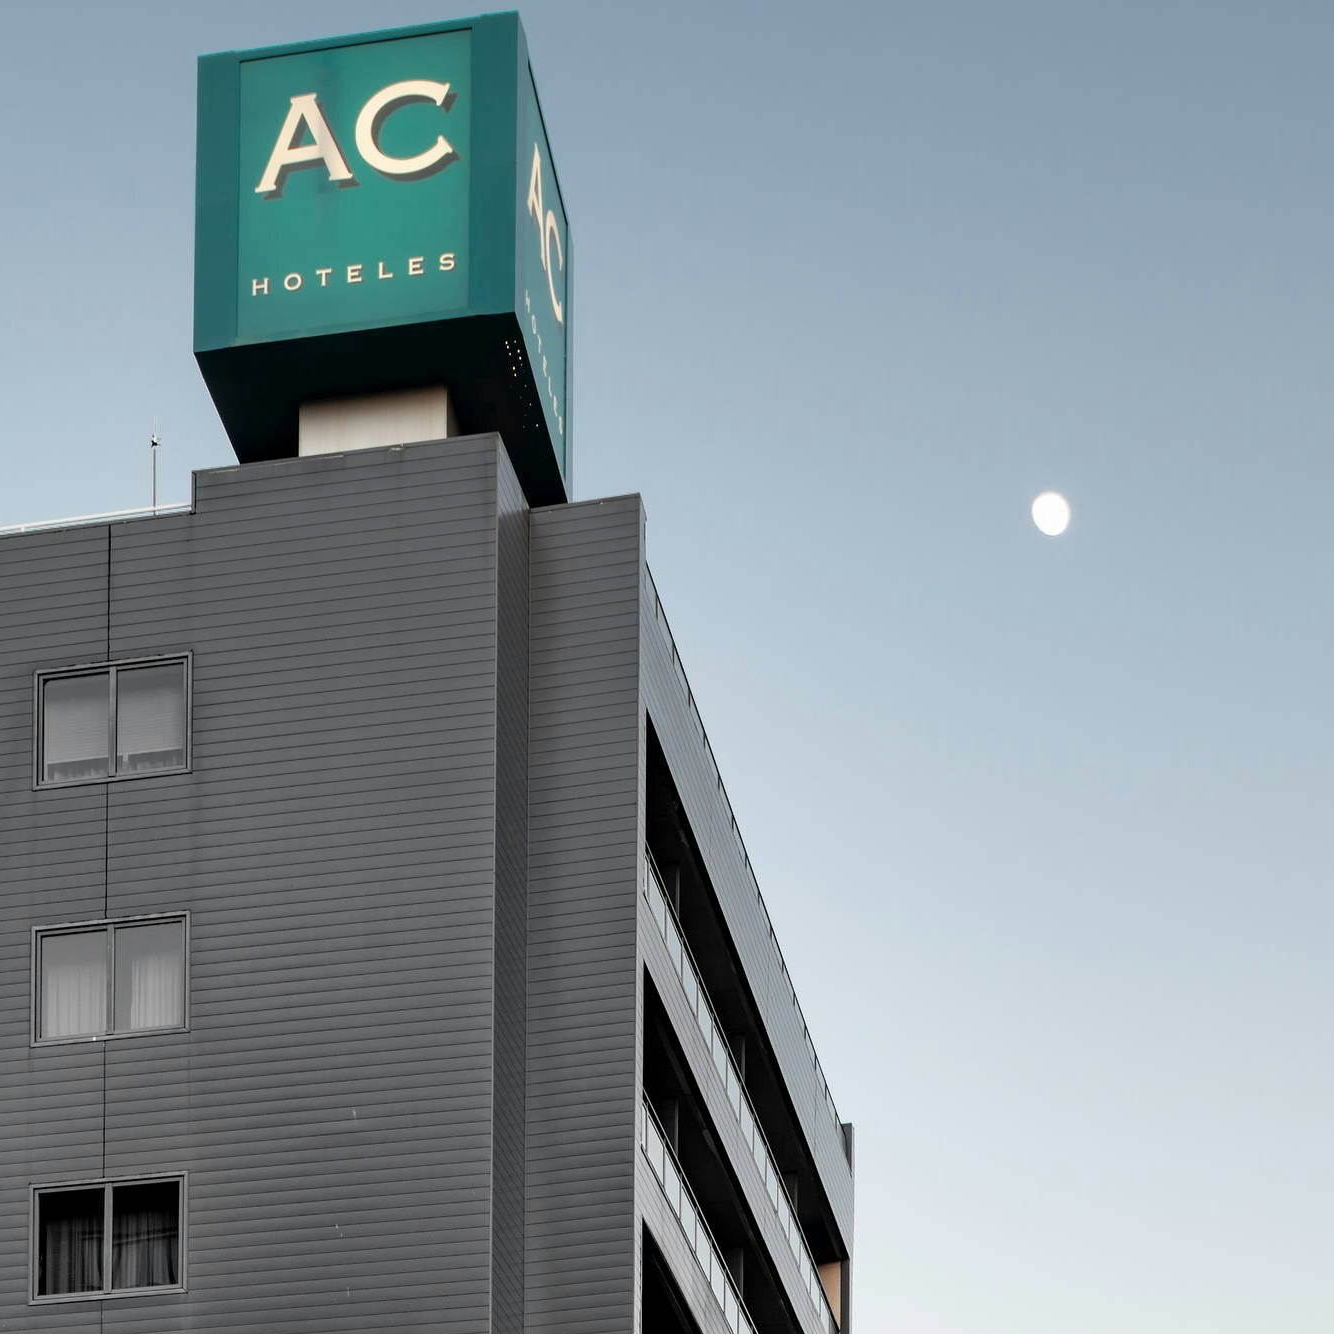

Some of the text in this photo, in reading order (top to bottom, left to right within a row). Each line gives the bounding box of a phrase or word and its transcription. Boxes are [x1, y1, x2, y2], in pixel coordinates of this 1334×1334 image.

[255, 79, 455, 195] AC
[252, 252, 457, 297] HOTELES
[527, 142, 563, 325] AC
